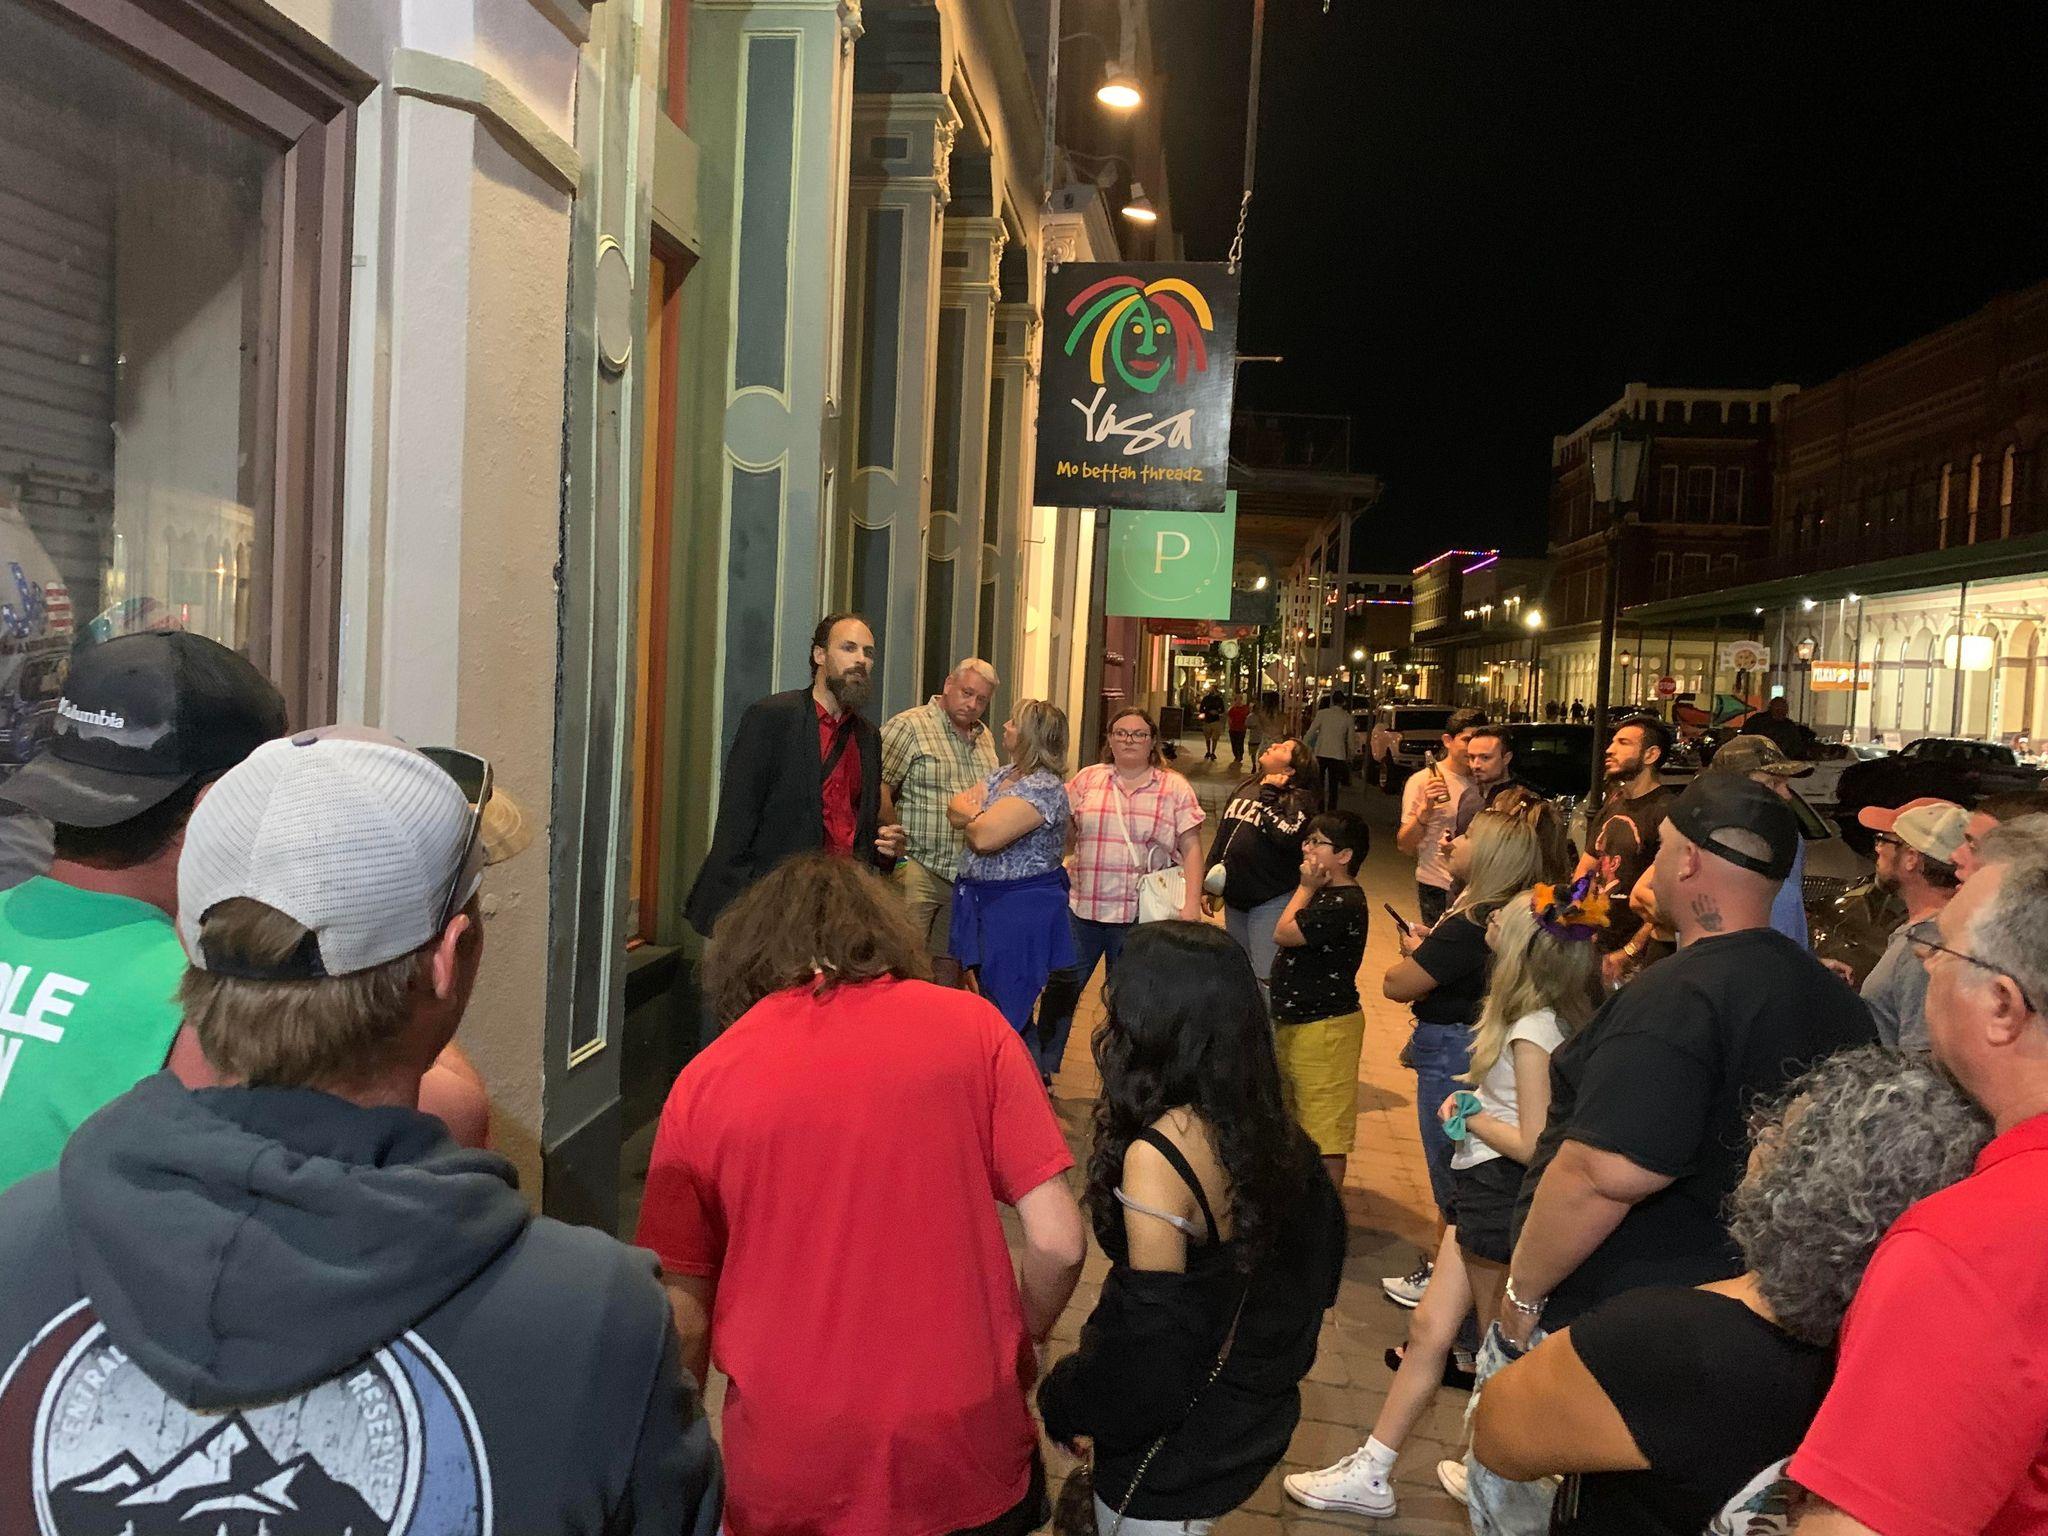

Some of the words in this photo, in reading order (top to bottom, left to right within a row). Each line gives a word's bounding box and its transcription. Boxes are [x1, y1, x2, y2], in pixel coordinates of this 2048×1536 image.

[1056, 460, 1079, 478] Mo
[1140, 464, 1204, 485] threadz
[1154, 531, 1191, 574] P
